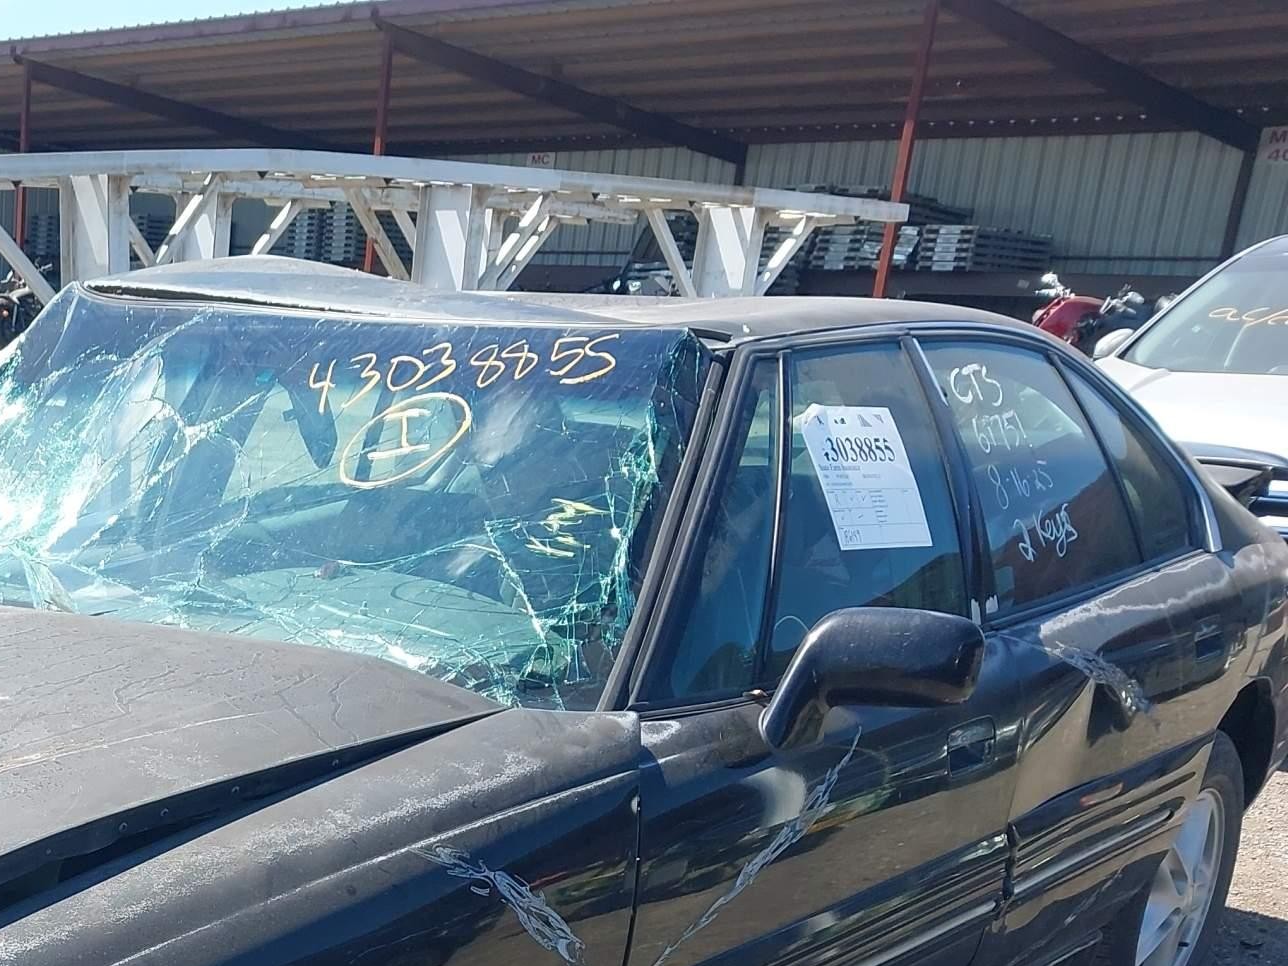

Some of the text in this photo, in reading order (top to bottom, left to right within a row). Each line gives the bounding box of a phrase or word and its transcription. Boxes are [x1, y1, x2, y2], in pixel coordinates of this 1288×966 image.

[531, 154, 551, 166] MC
[1012, 508, 1078, 563] 2 Keys
